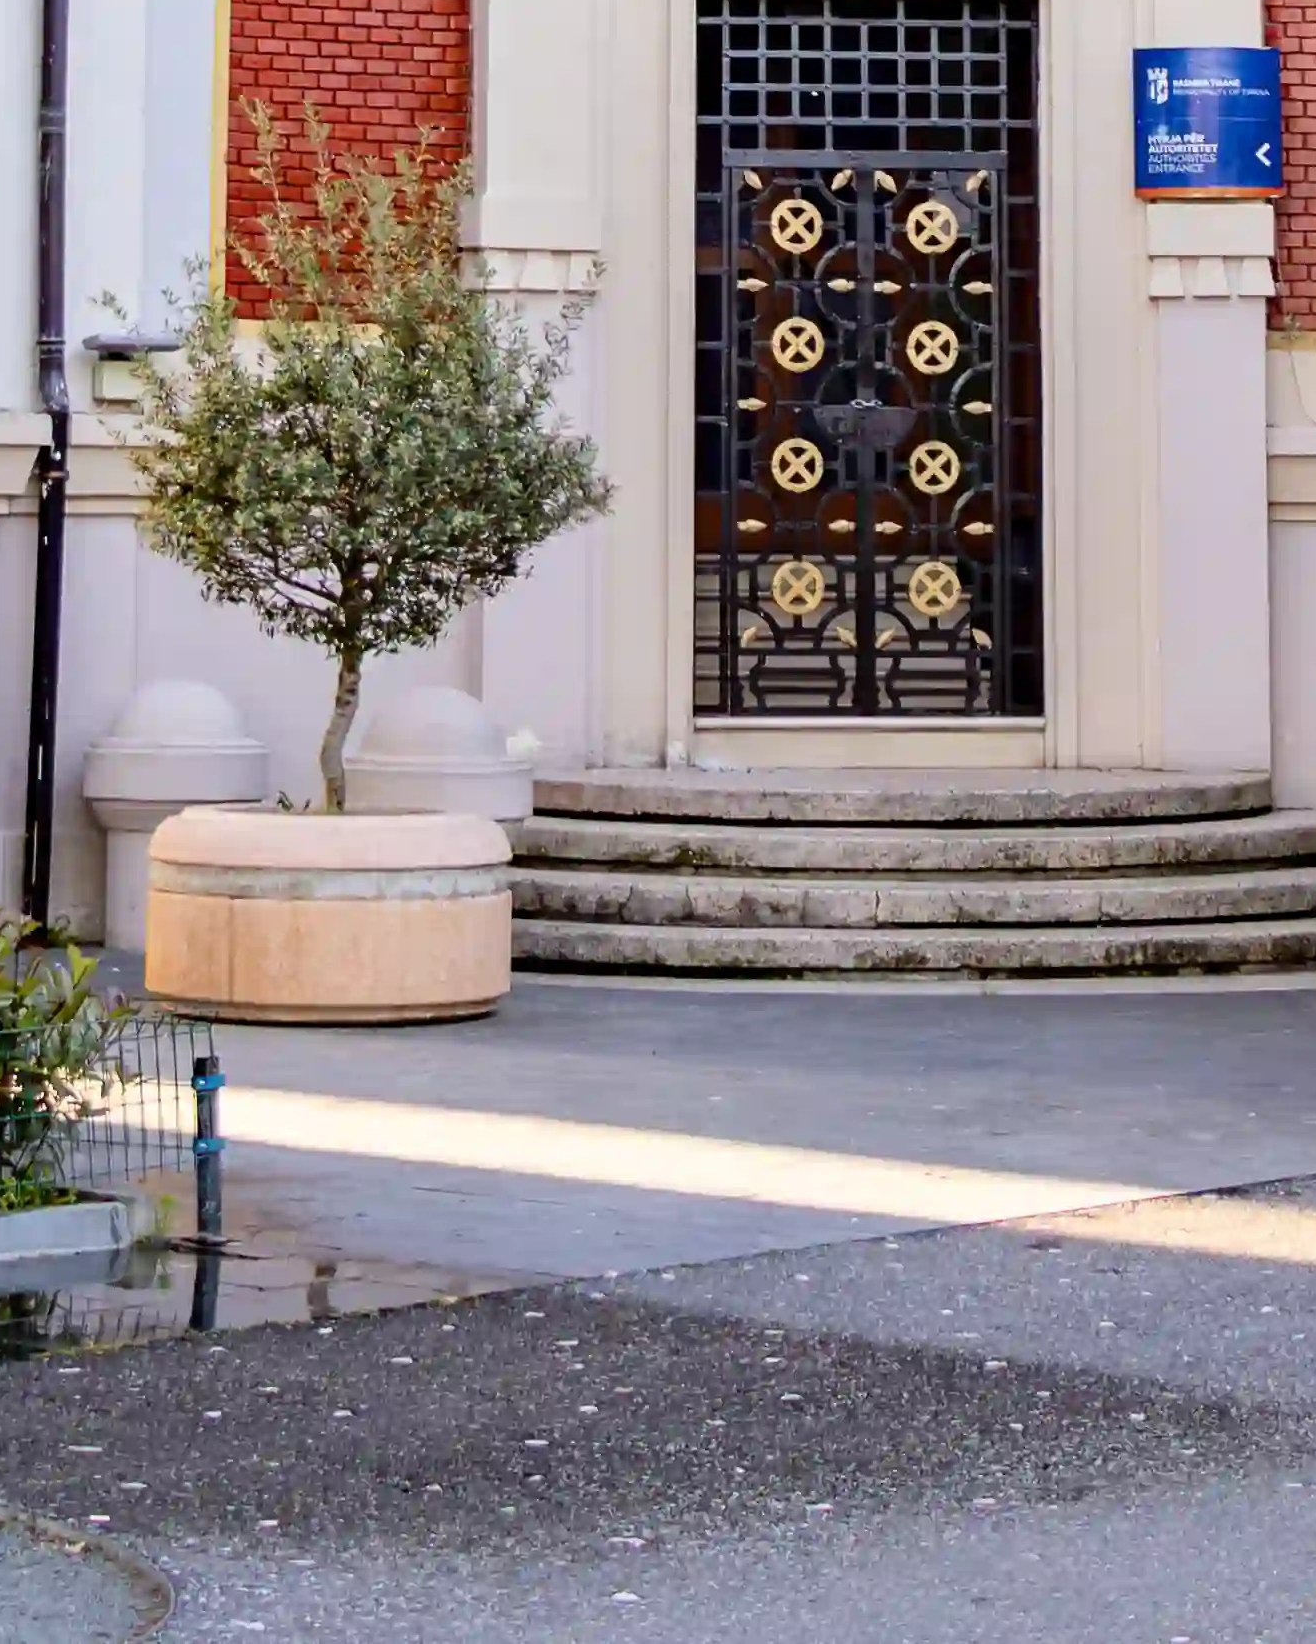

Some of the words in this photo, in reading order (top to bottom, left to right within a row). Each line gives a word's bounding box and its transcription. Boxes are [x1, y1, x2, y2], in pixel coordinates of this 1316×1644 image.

[1149, 143, 1218, 153] AUTORITETET
[1149, 154, 1217, 163] AUTHORITIES
[1149, 164, 1205, 173] ENTRANCE
